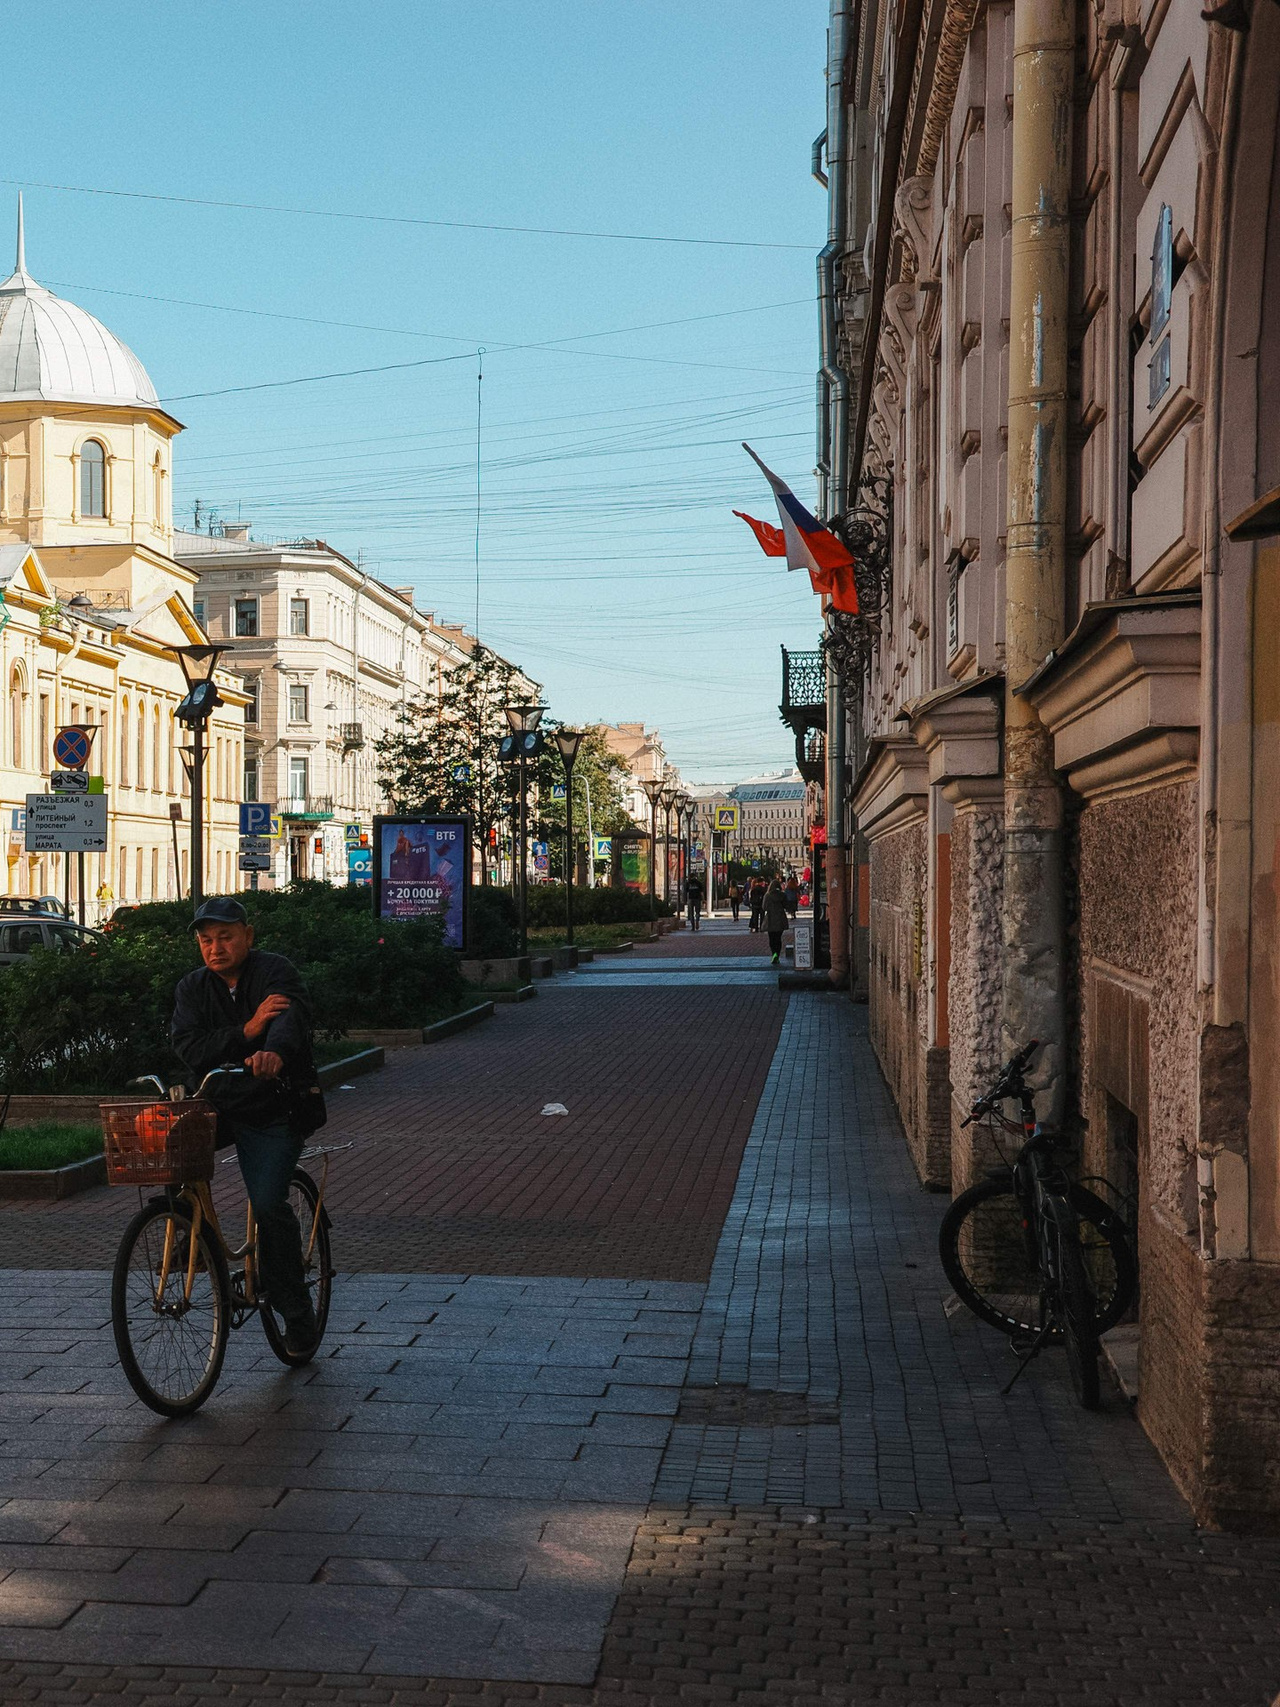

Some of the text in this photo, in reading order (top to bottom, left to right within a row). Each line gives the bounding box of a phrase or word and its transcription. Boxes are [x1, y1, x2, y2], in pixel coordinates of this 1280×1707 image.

[36, 796, 80, 804] РАЗЪЕЗЖАЯ
[84, 800, 94, 808] 0,3
[36, 804, 56, 812] улица
[35, 813, 76, 821] ЛИТЕЙНЫЙ
[247, 807, 264, 831] P
[84, 819, 94, 827] 1,2
[436, 831, 456, 840] ВТБ
[83, 838, 93, 846] 0,3
[411, 846, 427, 854] #ВТБ
[354, 860, 373, 872] OZ
